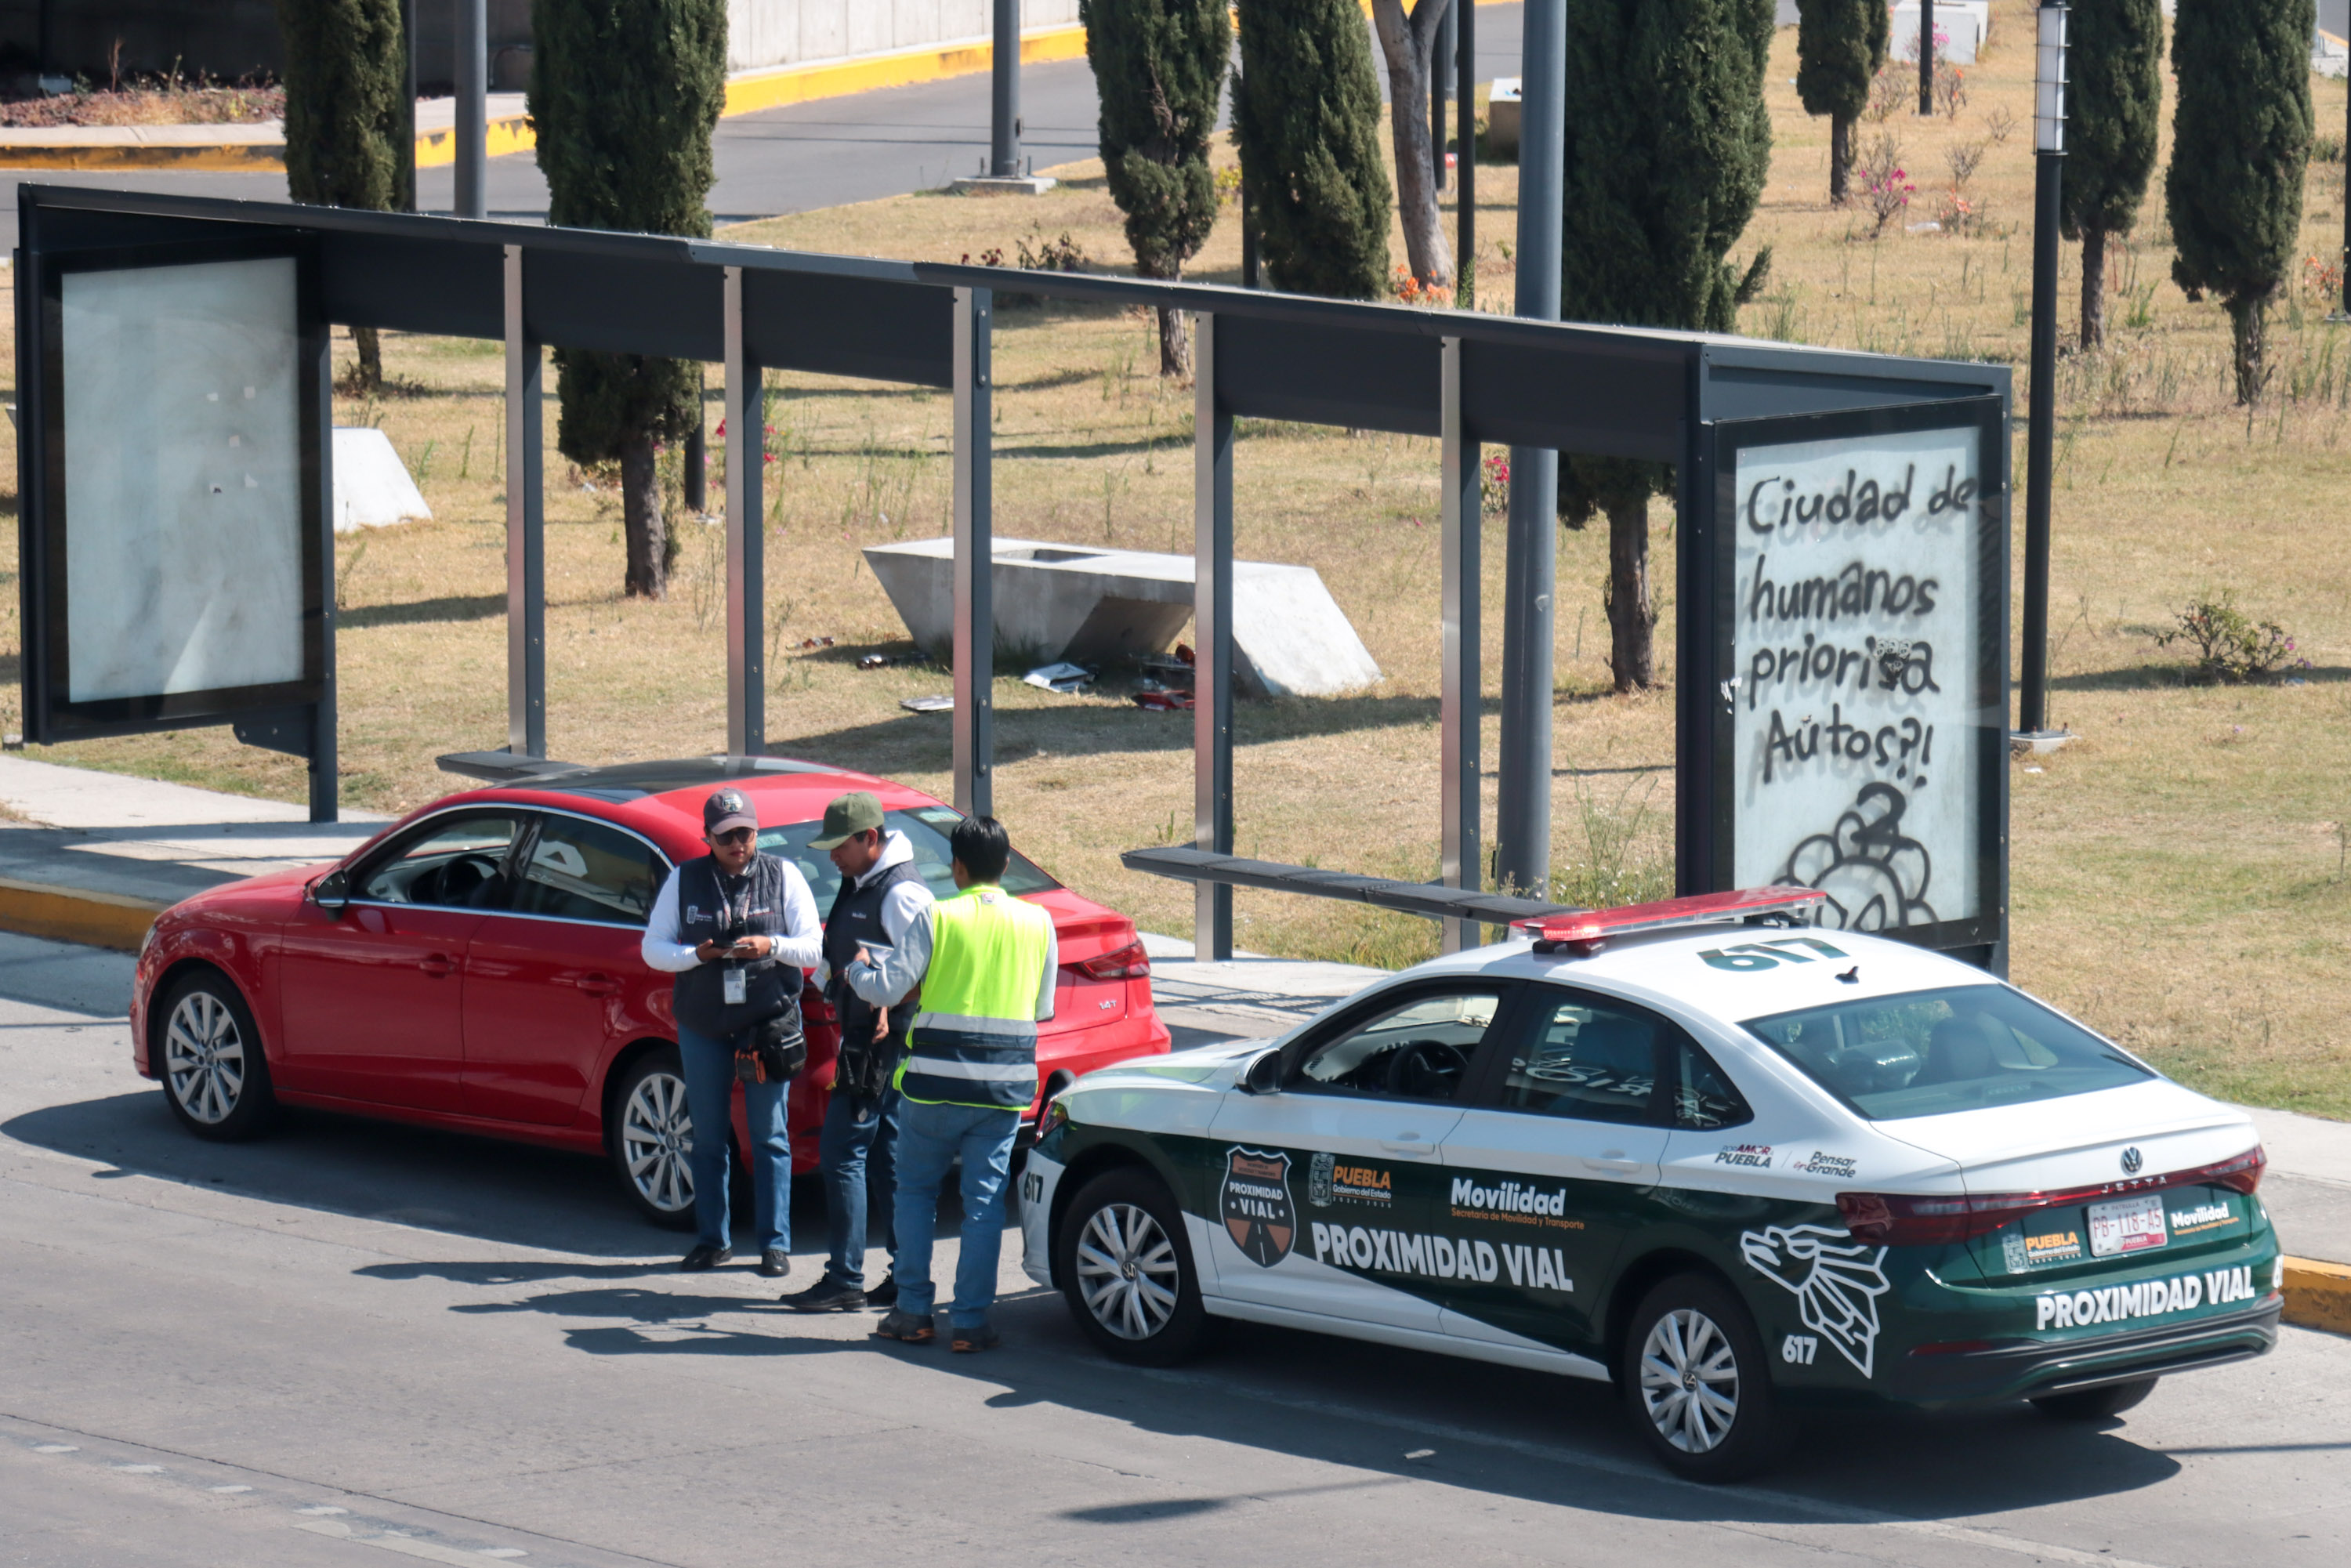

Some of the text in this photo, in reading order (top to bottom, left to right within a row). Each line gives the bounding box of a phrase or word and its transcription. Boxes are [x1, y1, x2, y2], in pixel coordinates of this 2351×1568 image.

[1748, 463, 1977, 534] Ciudad de
[1750, 553, 1939, 623] humanos
[1696, 936, 1850, 972] 617
[1715, 1152, 1772, 1168] PUEBLA
[1806, 1161, 1856, 1178] Grande
[1810, 1151, 1857, 1166] Pensar
[1023, 1171, 1044, 1204] 617
[1333, 1165, 1392, 1190] PUEBLA
[2101, 1176, 2167, 1193] JETTA
[1230, 1182, 1283, 1200] PROXIMIDAD
[1333, 1184, 1392, 1199] Gobierno del Estado
[1451, 1178, 1566, 1216] Movilidad
[1240, 1198, 1276, 1219] VIAL
[1502, 1213, 1537, 1225] Movilidad
[1538, 1218, 1543, 1227] y
[1545, 1217, 1585, 1229] Transporte
[2170, 1201, 2230, 1228] Movilidad
[2025, 1232, 2079, 1251] PUEBLA
[1311, 1222, 1574, 1292] PROXIMIDAD VIAL
[2037, 1266, 2255, 1331] PROXIMIDAD VIAL
[1782, 1334, 1817, 1365] 617
